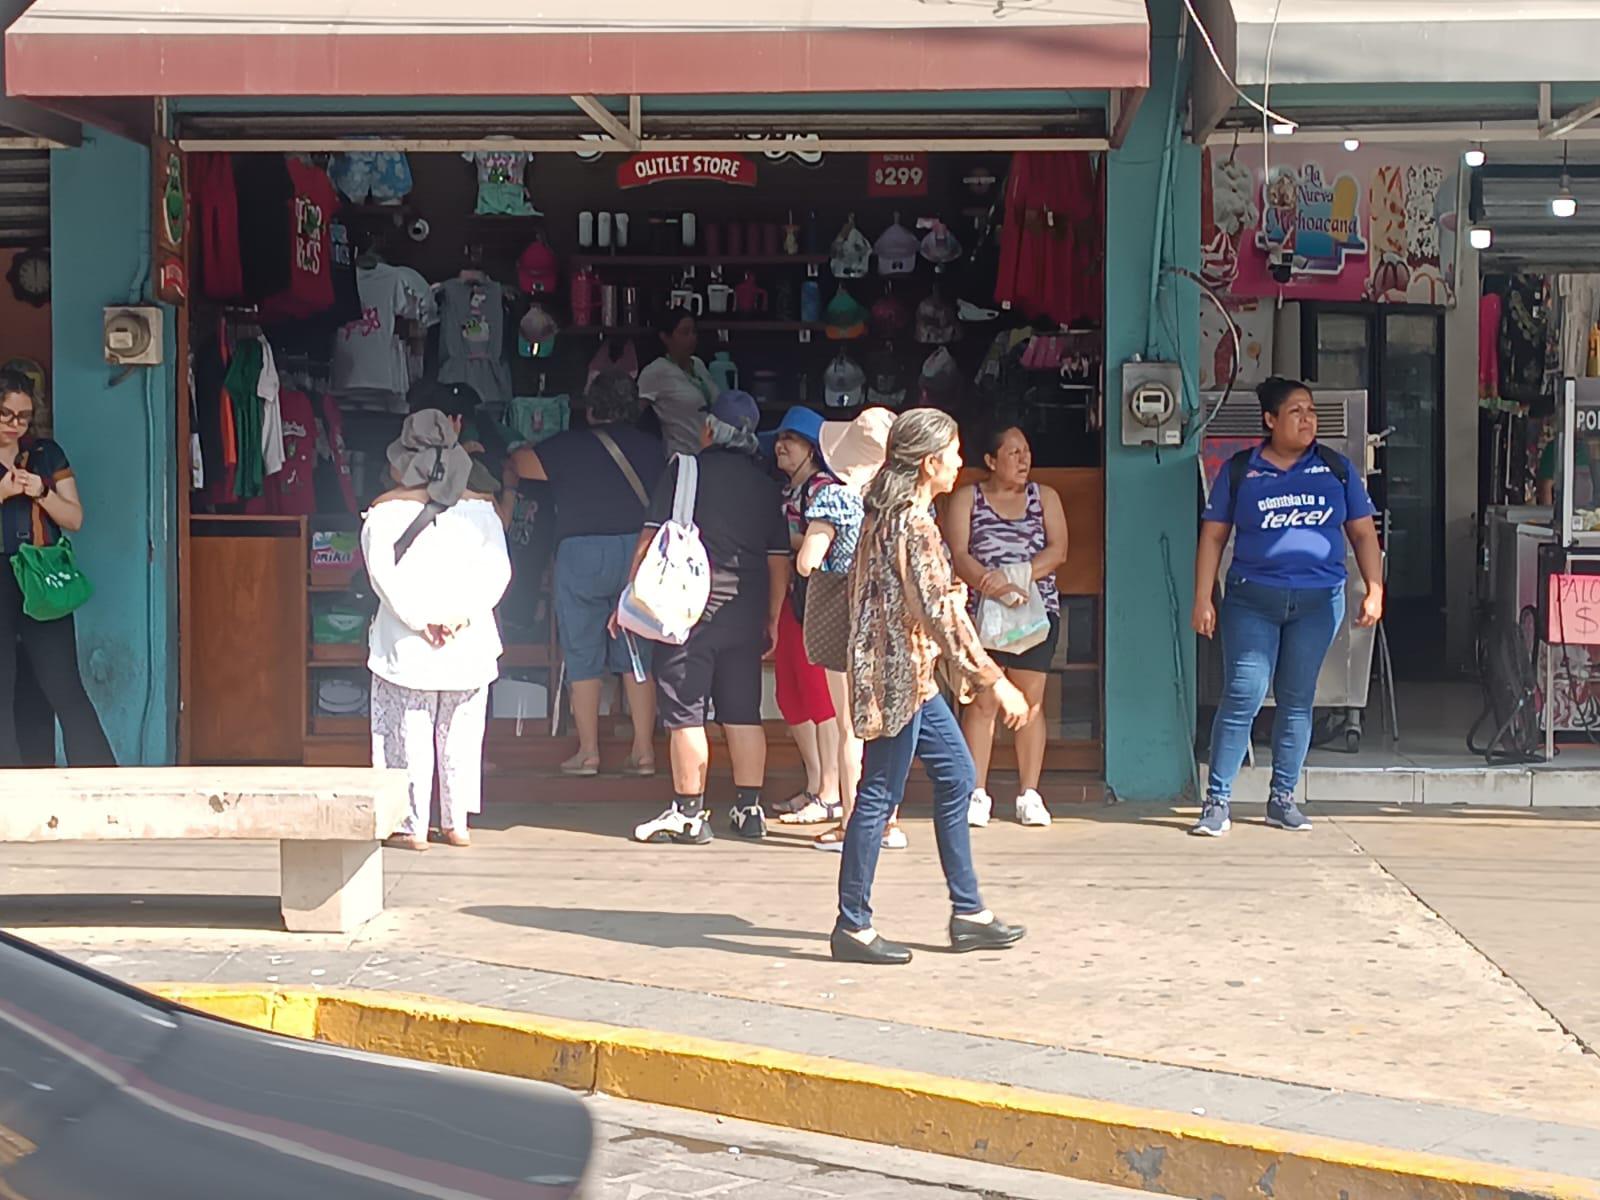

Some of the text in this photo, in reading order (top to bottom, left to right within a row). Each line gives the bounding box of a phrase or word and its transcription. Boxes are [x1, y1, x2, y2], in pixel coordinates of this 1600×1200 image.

[634, 155, 741, 178] OUTLET STORE
[875, 166, 923, 186] $299
[1304, 164, 1322, 188] La
[1298, 185, 1334, 206] Nueva
[1576, 410, 1600, 430] PO
[1260, 506, 1334, 529] telcel
